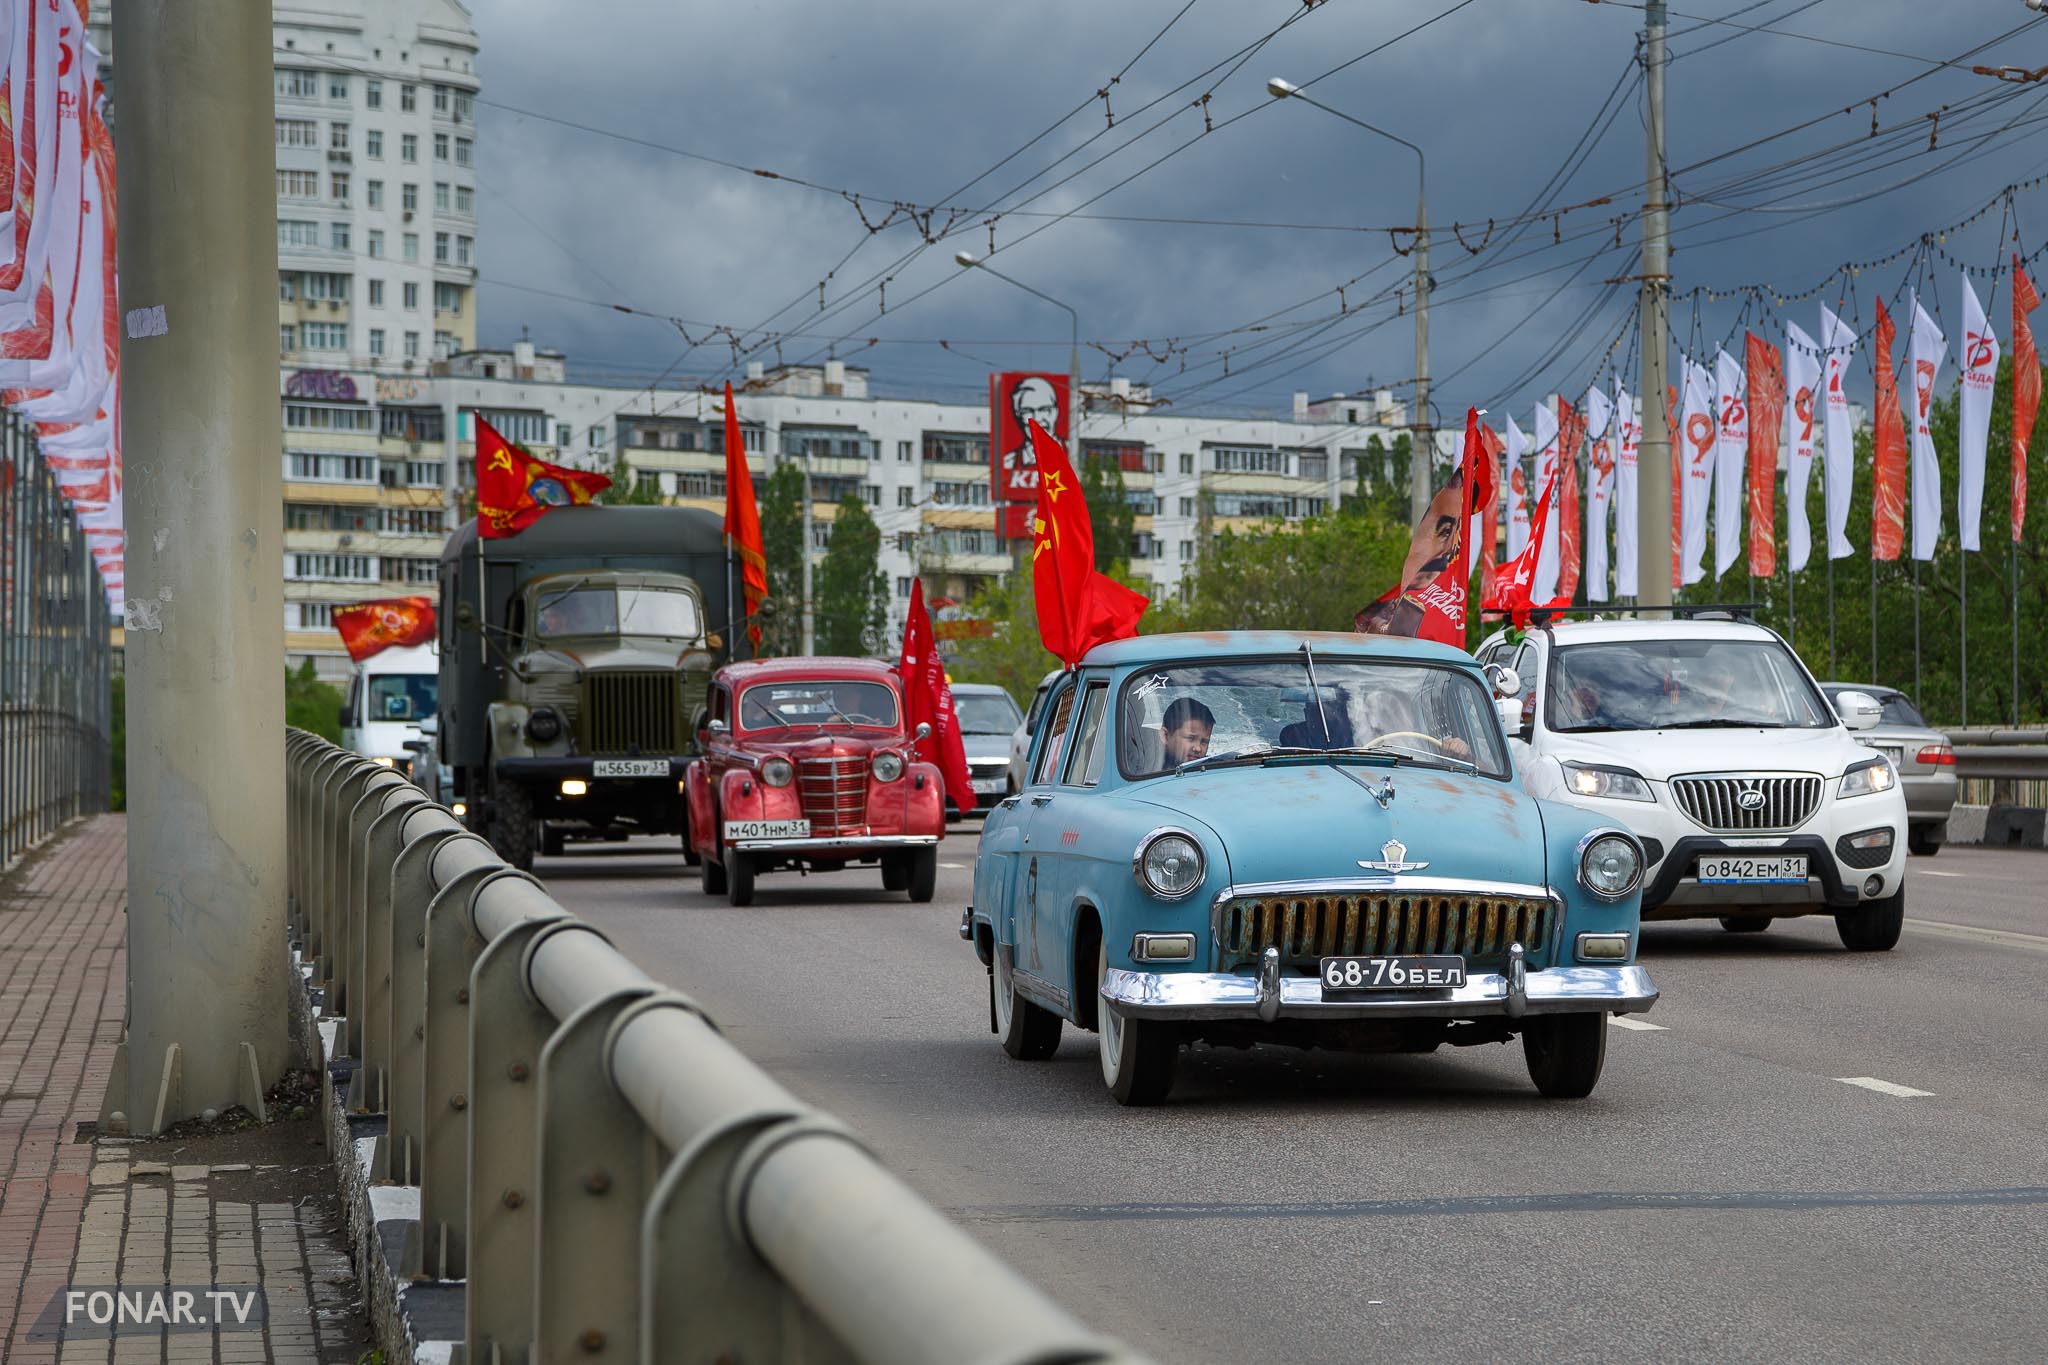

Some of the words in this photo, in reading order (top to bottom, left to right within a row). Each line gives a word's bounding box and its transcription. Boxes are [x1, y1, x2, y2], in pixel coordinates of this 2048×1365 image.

[1795, 386, 1813, 441] 9
[1687, 413, 1715, 464] 9
[729, 823, 788, 837] М401НМ
[1706, 860, 1779, 878] О842ЕМ
[1783, 859, 1801, 873] 31
